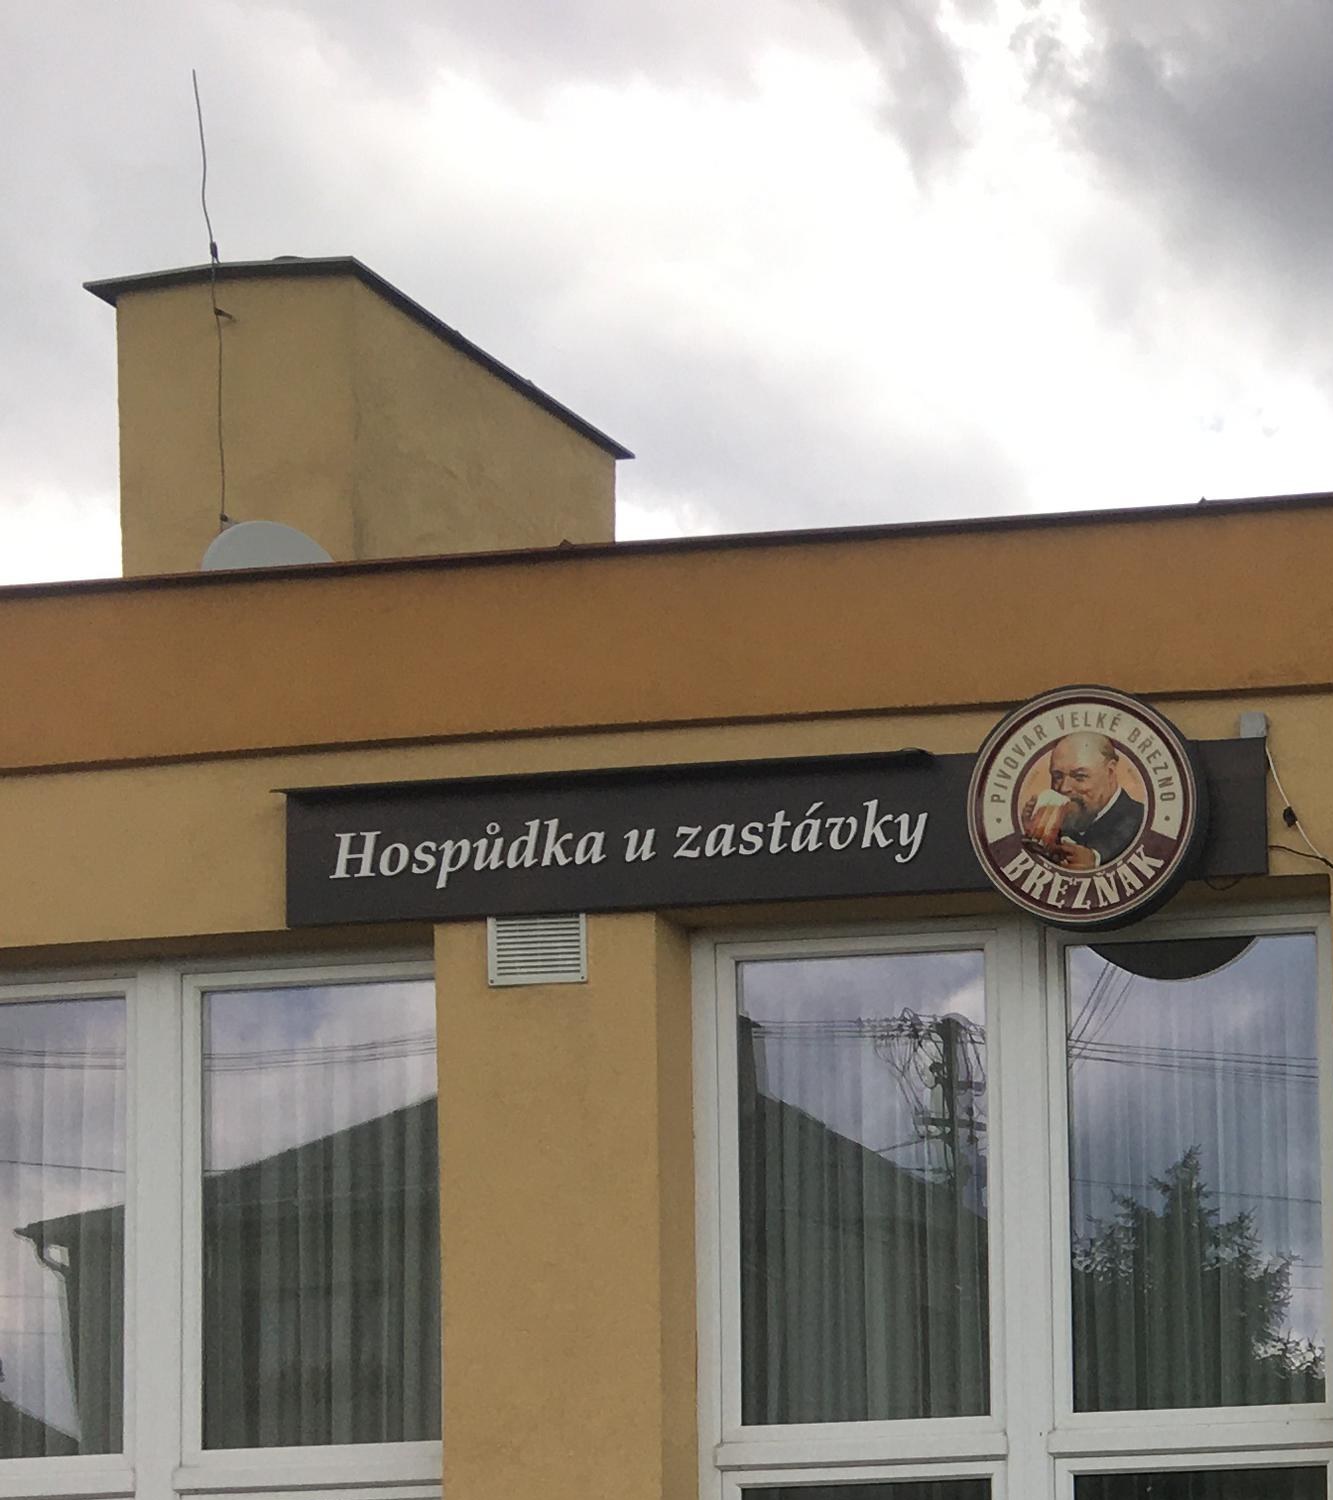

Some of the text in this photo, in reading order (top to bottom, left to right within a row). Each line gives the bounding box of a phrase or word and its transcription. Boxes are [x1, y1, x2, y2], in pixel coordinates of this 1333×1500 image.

[990, 711, 1177, 804] PIVOVAR VELKÉ BŘEZNO
[329, 799, 928, 889] Hospůdka u zastávky
[1001, 844, 1165, 910] BŘEZŇÁK
